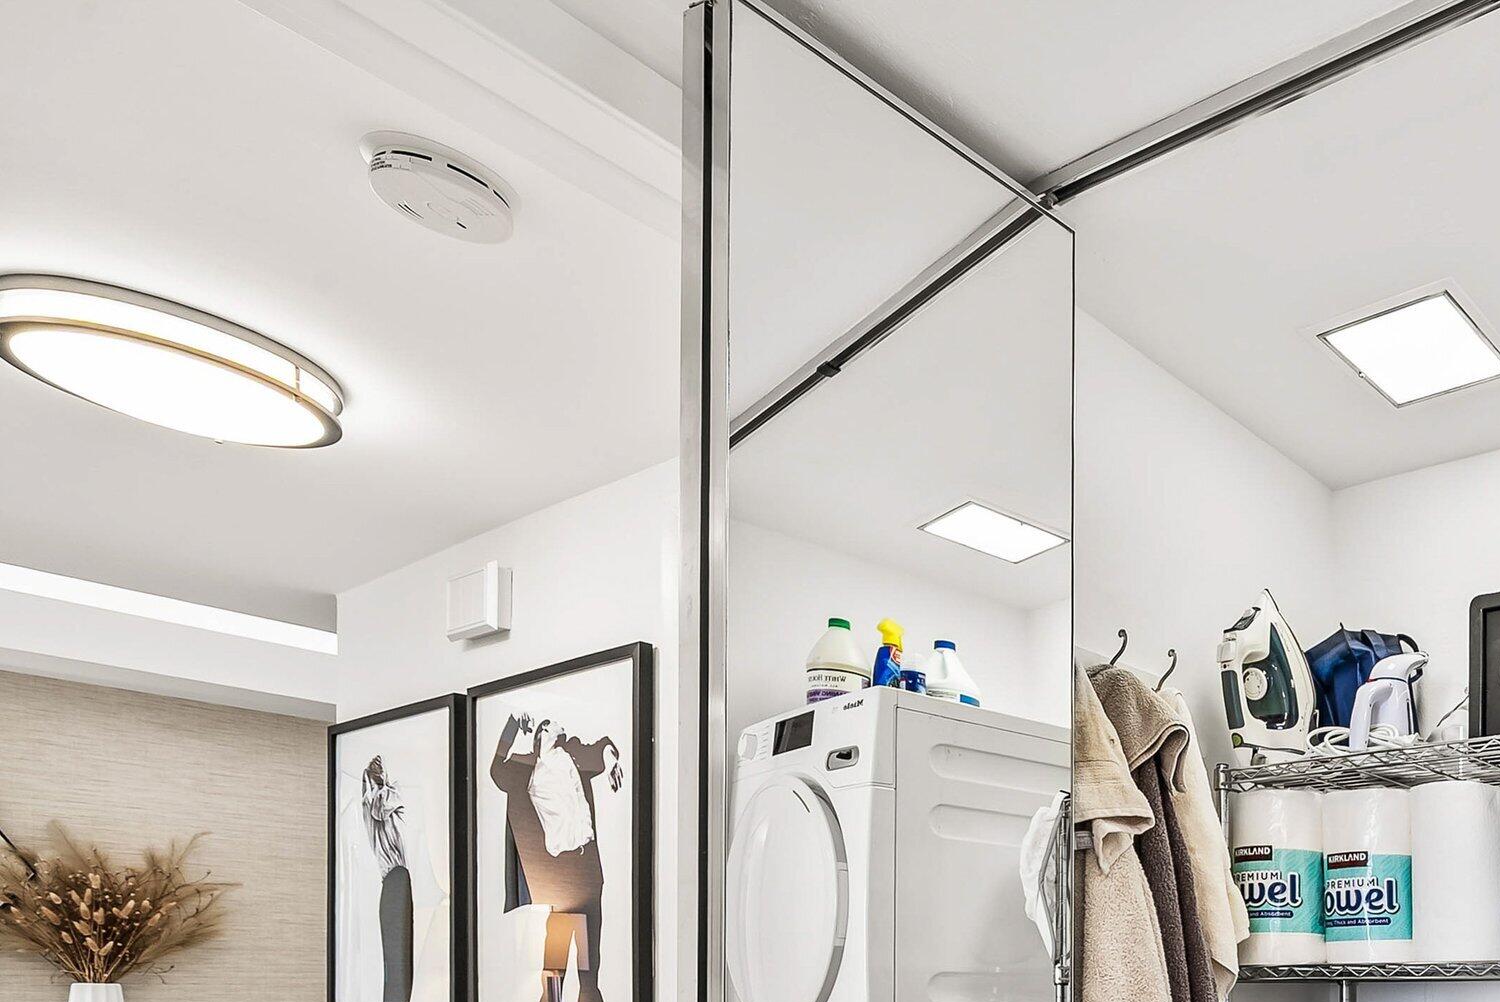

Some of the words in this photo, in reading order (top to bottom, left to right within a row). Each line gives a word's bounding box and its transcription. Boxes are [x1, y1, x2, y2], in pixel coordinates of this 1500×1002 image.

[1235, 847, 1270, 857] KIRKLAND
[1328, 852, 1367, 863] KIRKLAND
[1241, 874, 1298, 904] wel
[1325, 880, 1396, 912] owel
